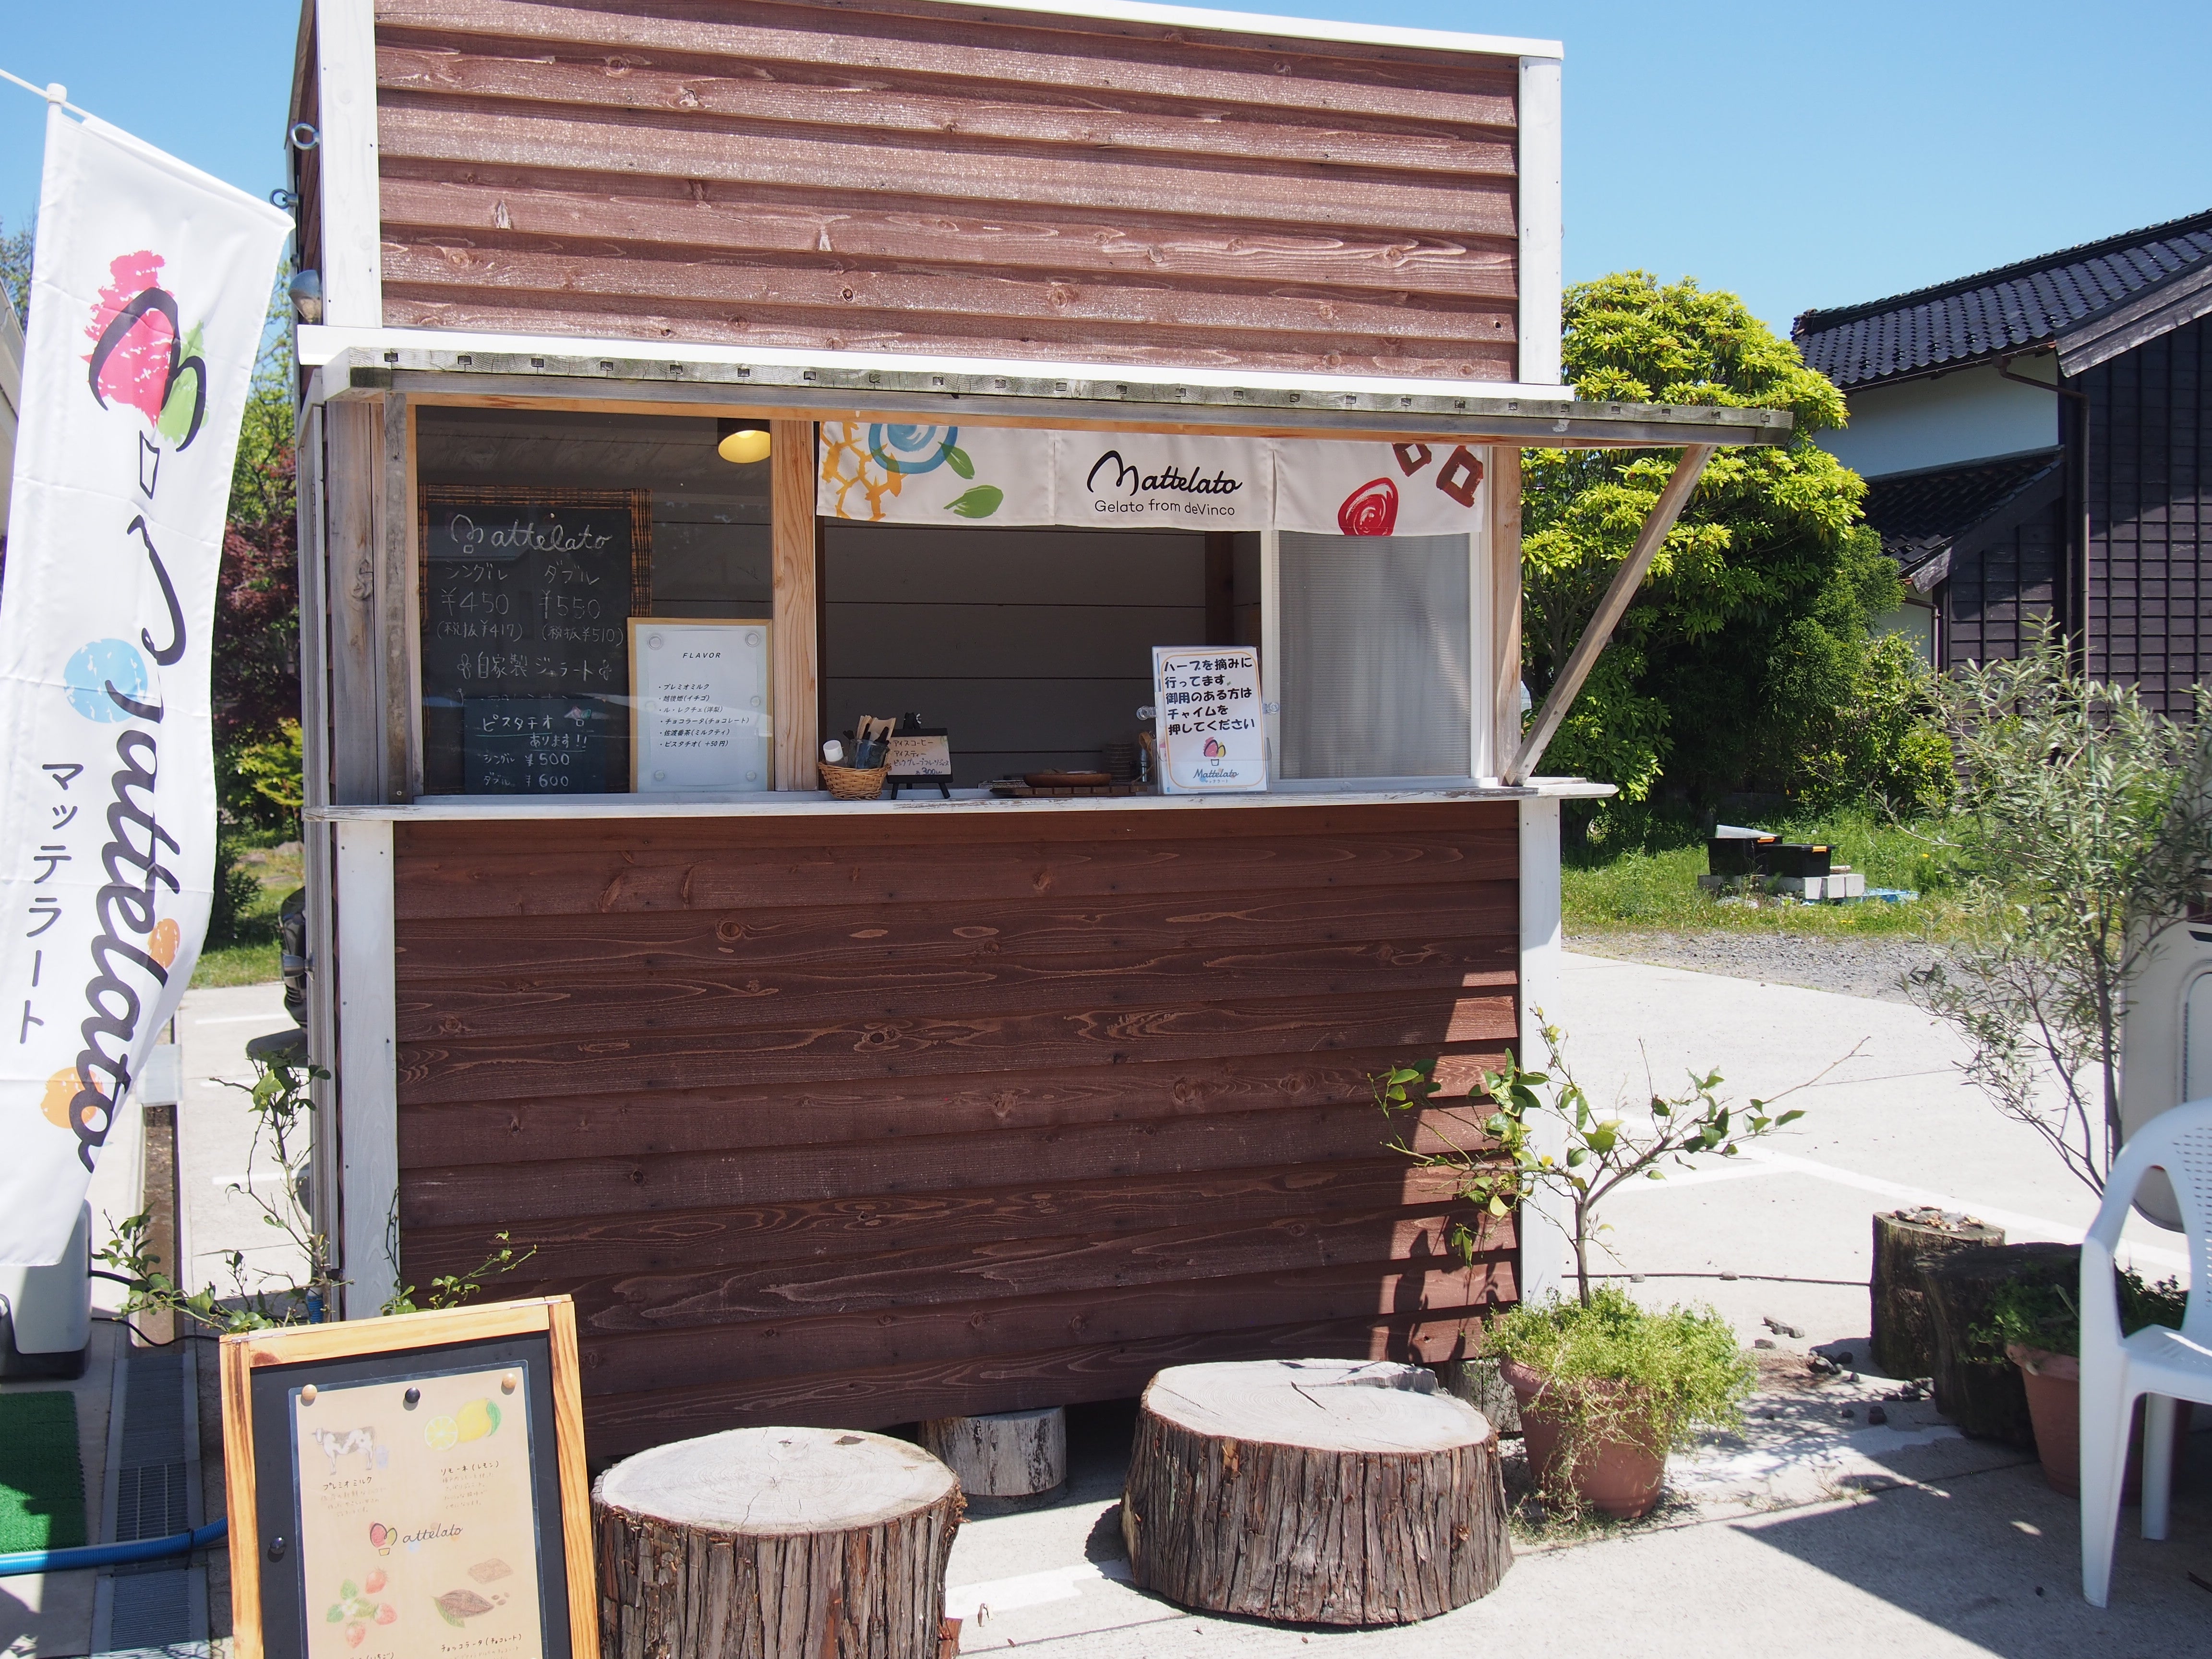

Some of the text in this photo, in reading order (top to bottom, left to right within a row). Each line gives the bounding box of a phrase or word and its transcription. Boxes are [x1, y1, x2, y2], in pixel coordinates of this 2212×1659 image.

[1087, 450, 1243, 496] Mattelato
[1094, 499, 1235, 516] Gelato from deVinco
[445, 560, 600, 585] シングル ダブル
[442, 587, 601, 619] ¥450 ¥550
[1164, 658, 1252, 672] ハーブを摘みに
[1166, 687, 1252, 705] 御用のある方は
[1167, 705, 1228, 720] チャイムを
[483, 715, 553, 732] ピスタチオ
[1168, 719, 1255, 735] 押してください
[483, 753, 570, 767] シングル ¥500
[1193, 769, 1239, 779] Mattelato
[20, 764, 84, 1044] マッテラート
[441, 1460, 499, 1476] リモーネ(レモン)
[323, 1477, 372, 1491] プレミオミルク
